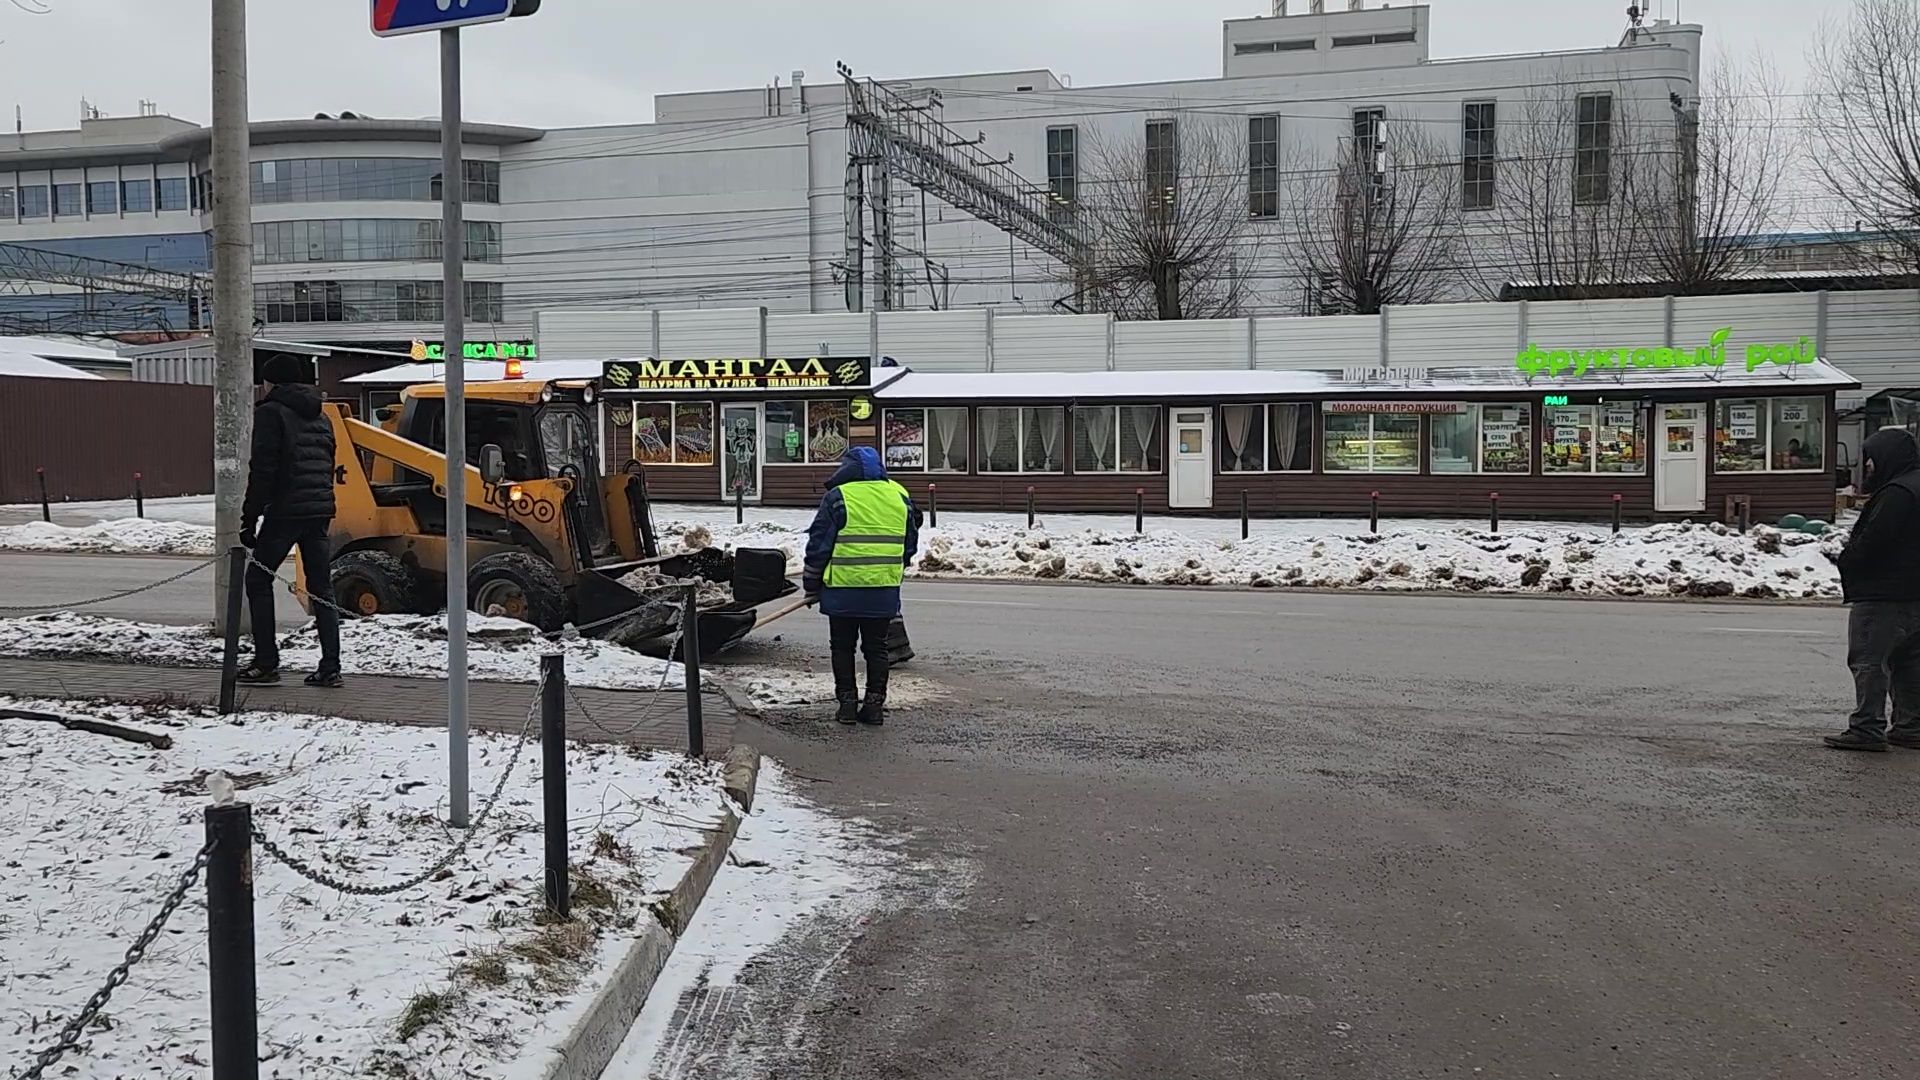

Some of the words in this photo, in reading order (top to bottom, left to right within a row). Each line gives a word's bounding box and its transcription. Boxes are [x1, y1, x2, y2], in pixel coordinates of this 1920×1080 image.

[427, 343, 498, 359] ССА
[1516, 327, 1732, 378] фруктовый
[1743, 336, 1817, 373] рай
[638, 357, 831, 378] МАНГАЛ
[1342, 366, 1373, 381] МИР
[1376, 366, 1429, 380] СЫРОВ
[638, 379, 691, 388] ШАУРМА
[694, 379, 711, 388] НА
[714, 378, 757, 388] УГЛЯХ
[767, 377, 831, 388] ШАШЛЫК
[1331, 403, 1391, 413] МОЛОЧНАЯ
[1392, 403, 1457, 413] ПРОДУКЦИЯ
[1556, 415, 1570, 424] 170
[1610, 415, 1625, 424] 180
[1783, 411, 1801, 421] 200
[1731, 428, 1747, 436] 170
